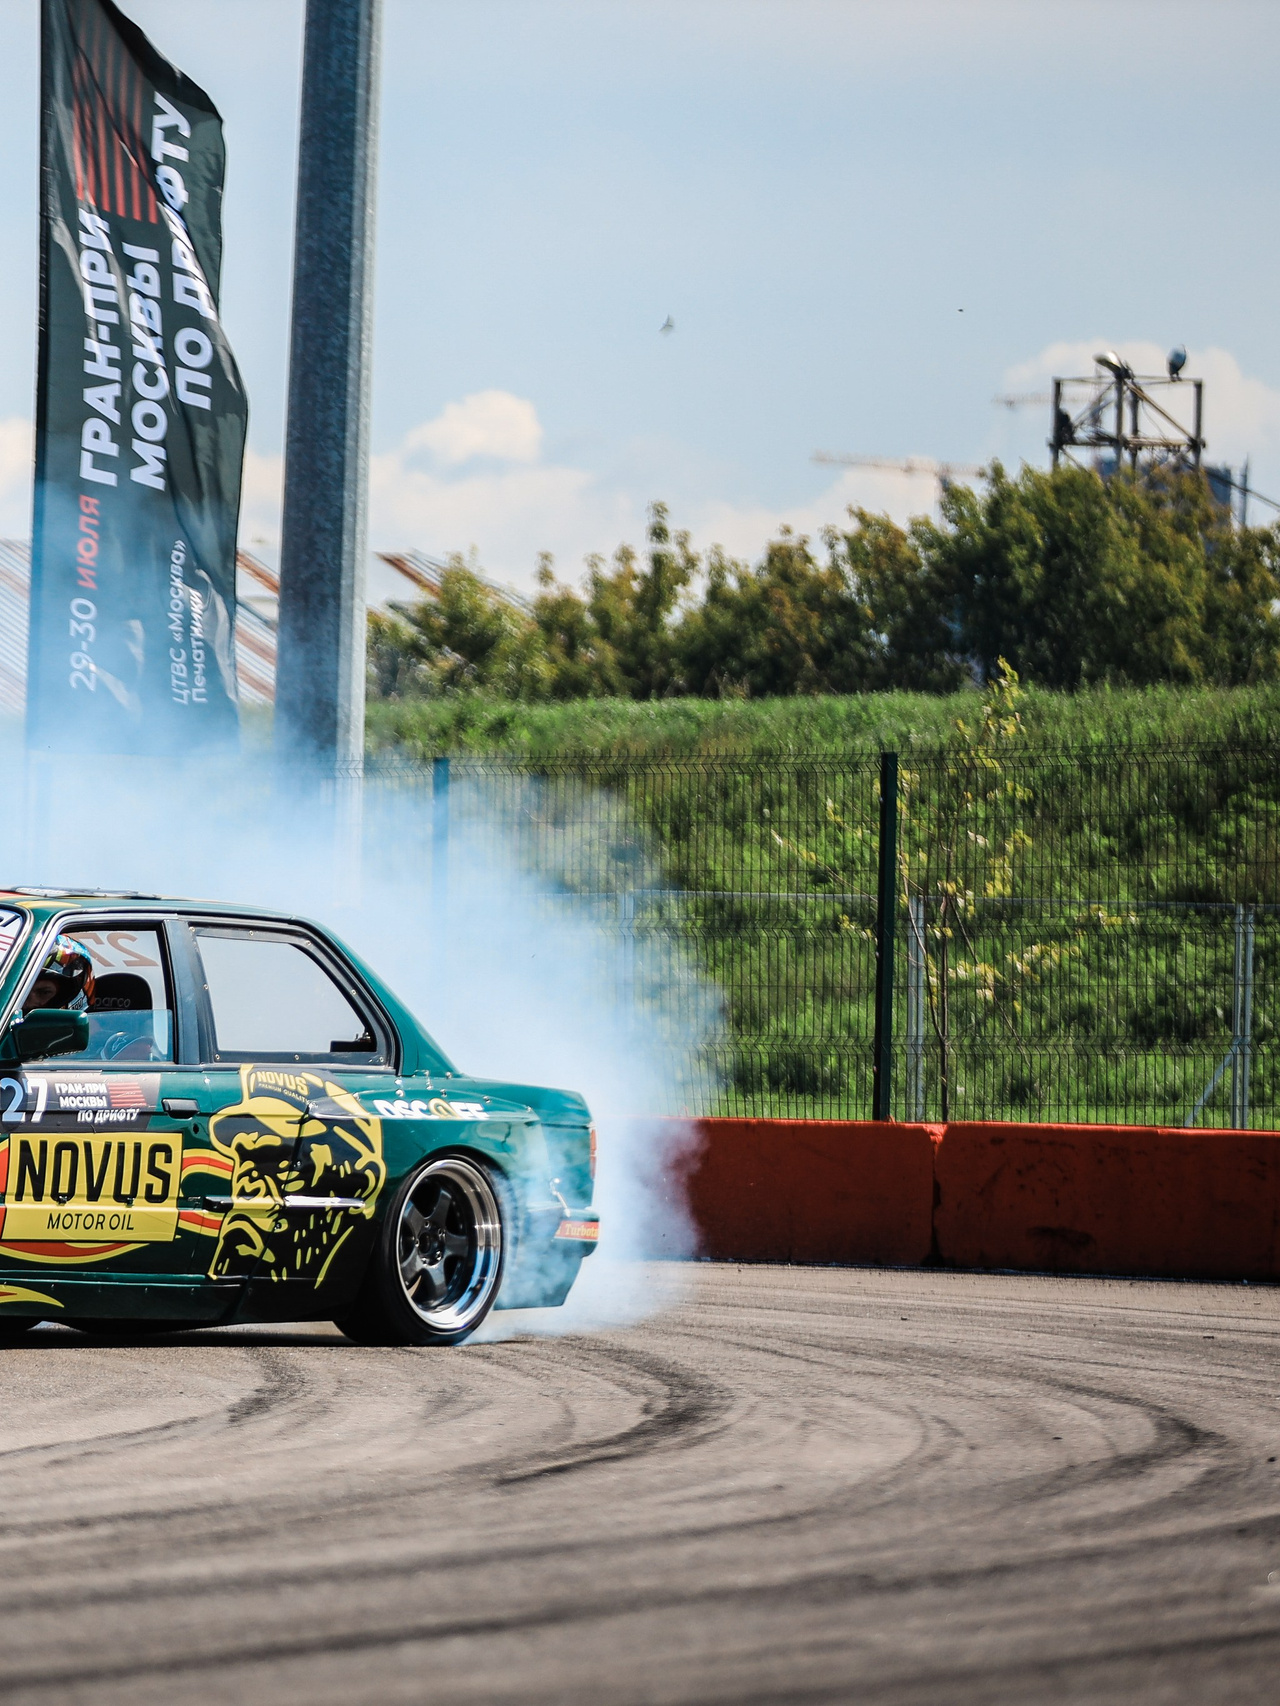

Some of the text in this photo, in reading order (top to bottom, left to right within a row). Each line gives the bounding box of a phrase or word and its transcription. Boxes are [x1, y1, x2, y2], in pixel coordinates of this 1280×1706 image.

[79, 207, 122, 487] ГРАН-ПРИ
[122, 241, 169, 492] МОСКВЫ
[174, 327, 214, 411] ПО
[69, 494, 101, 693] 29-30 ИЮЛЯ
[93, 996, 131, 1009] parco
[54, 1082, 107, 1094] ГРАН-ПРИ
[256, 1071, 310, 1097] NOVUS
[257, 1083, 282, 1092] PREMIUM
[0, 1077, 48, 1123] 27
[59, 1095, 107, 1108] МОСКВЫ
[77, 1108, 140, 1124] ПО ДРИФТУ
[14, 1139, 173, 1204] NOVUS
[46, 1212, 134, 1231] MOTOR OIL
